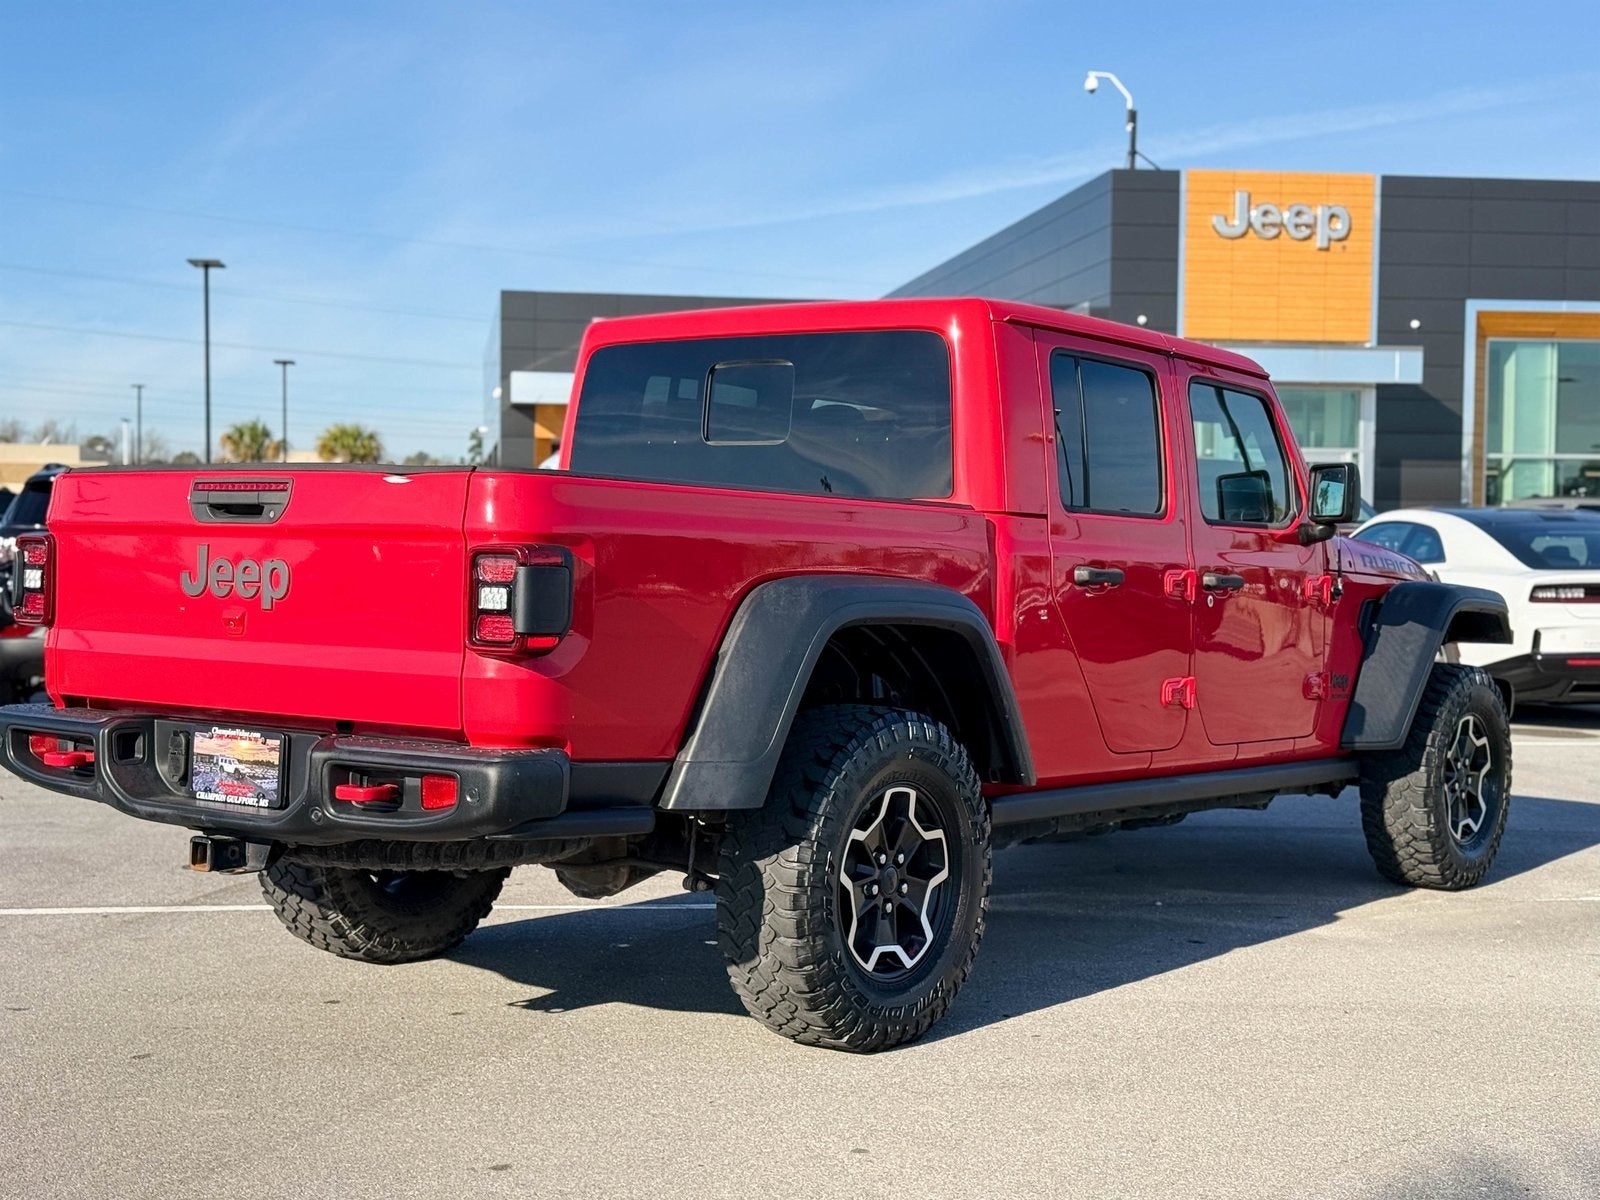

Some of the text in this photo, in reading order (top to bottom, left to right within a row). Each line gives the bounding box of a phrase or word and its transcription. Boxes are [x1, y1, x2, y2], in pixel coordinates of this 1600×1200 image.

[1212, 190, 1352, 250] Jeep
[180, 543, 291, 611] Jeep
[1361, 554, 1418, 576] RUBICO
[196, 791, 226, 802] CHAMPION
